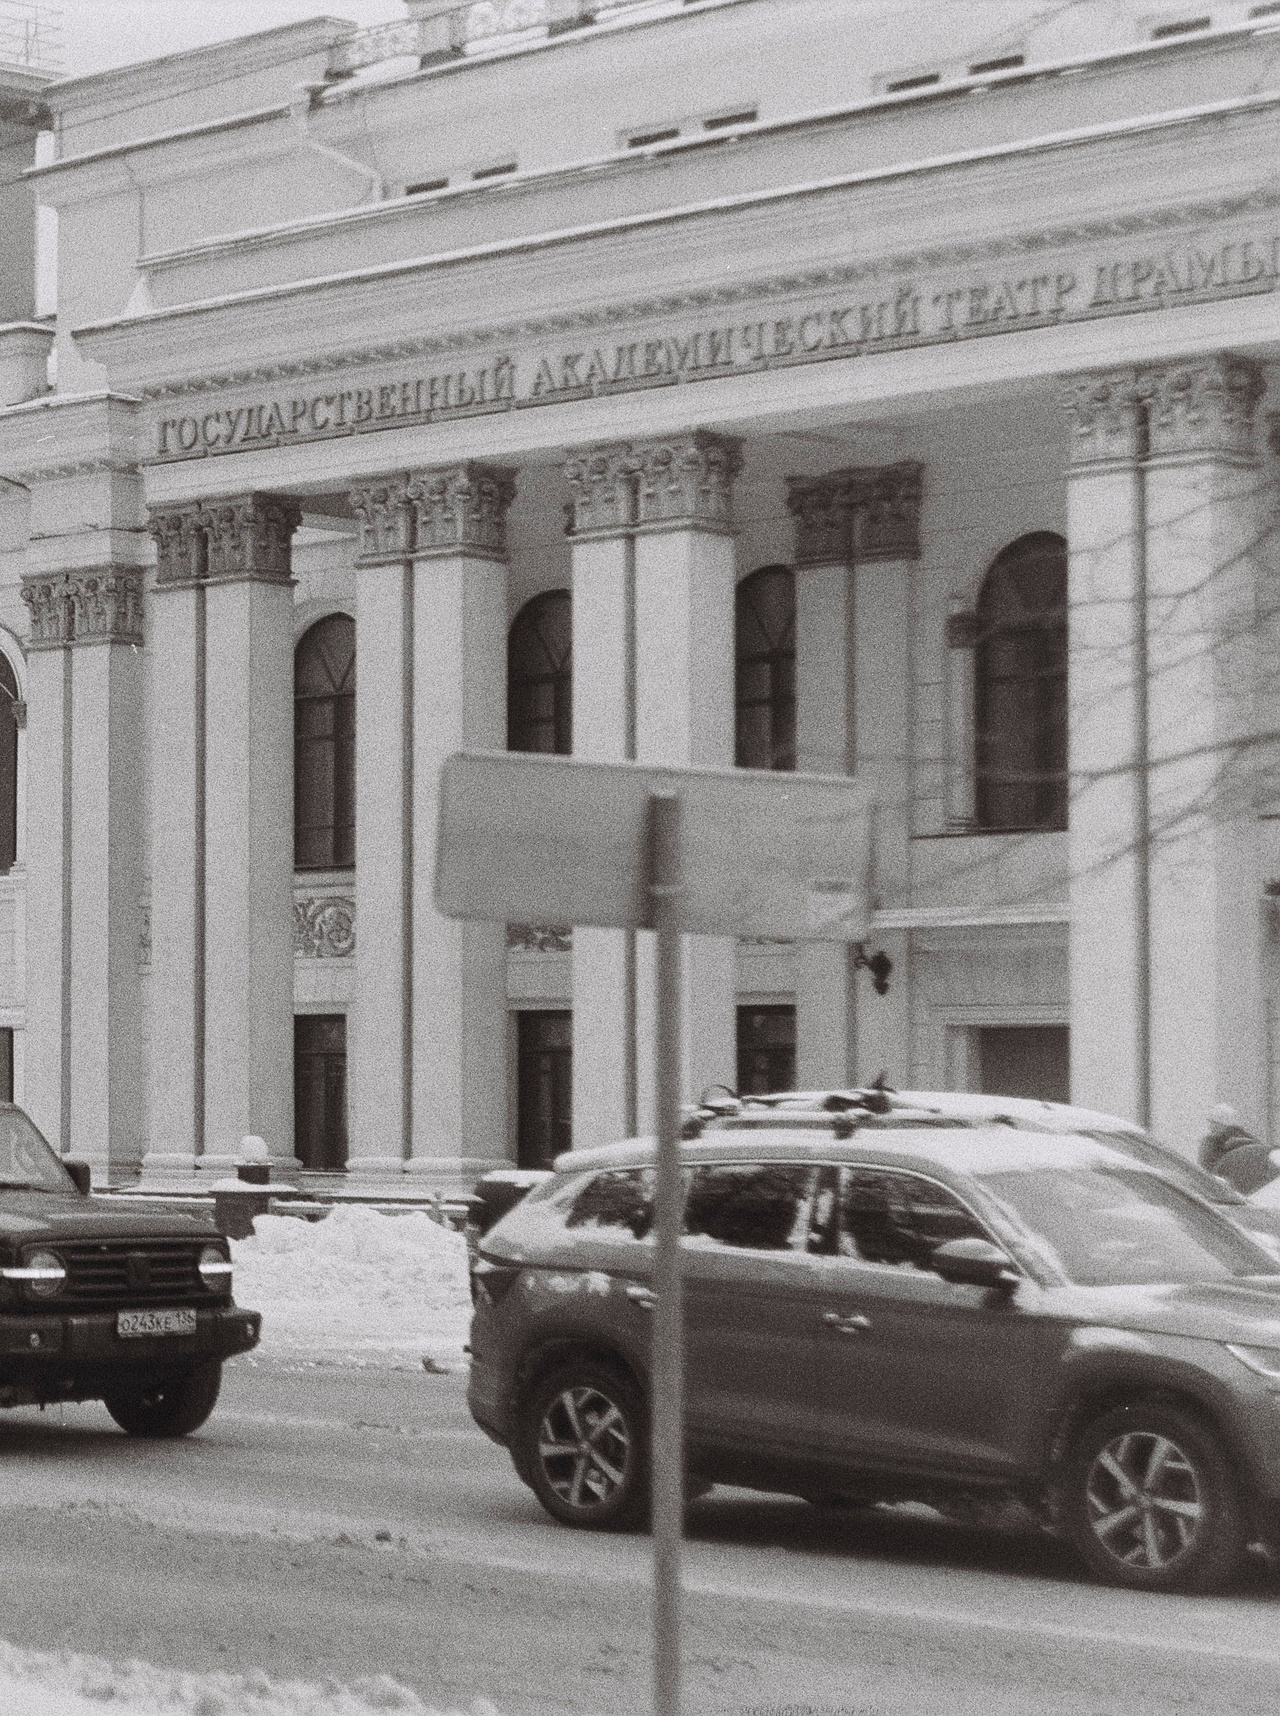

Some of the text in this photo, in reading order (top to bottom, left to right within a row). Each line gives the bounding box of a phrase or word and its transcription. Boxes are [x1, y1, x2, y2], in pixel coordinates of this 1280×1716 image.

[156, 355, 518, 456] ГОСУДАРСТВЕННЫЙ
[530, 282, 923, 397] АКАДЕМИЧЕСКИЙ
[932, 272, 1077, 332] ТЕАТР
